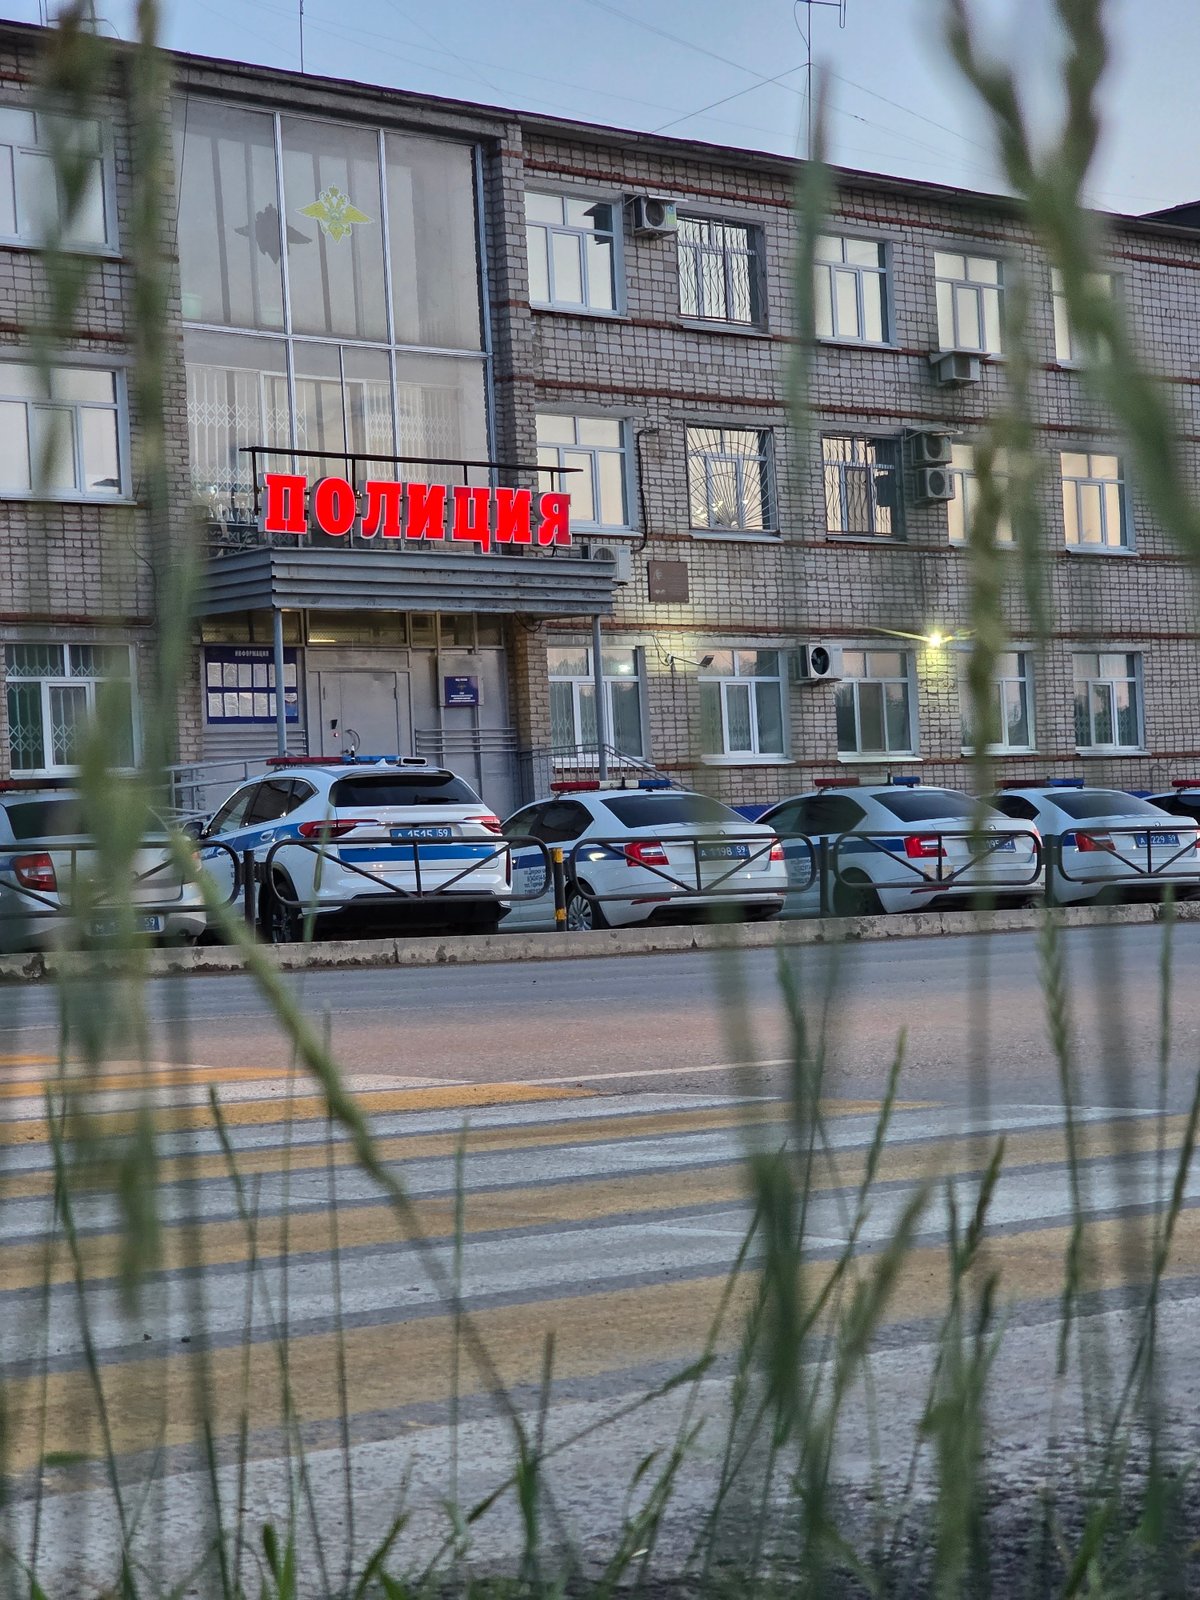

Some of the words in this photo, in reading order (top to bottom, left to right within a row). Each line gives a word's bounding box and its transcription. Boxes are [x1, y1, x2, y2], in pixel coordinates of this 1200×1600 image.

[264, 473, 573, 553] ПОЛИЦИЯ
[407, 829, 433, 838] 1515
[438, 828, 449, 837] 59
[1167, 834, 1176, 842] 59
[736, 845, 746, 853] 59
[144, 917, 156, 927] 59
